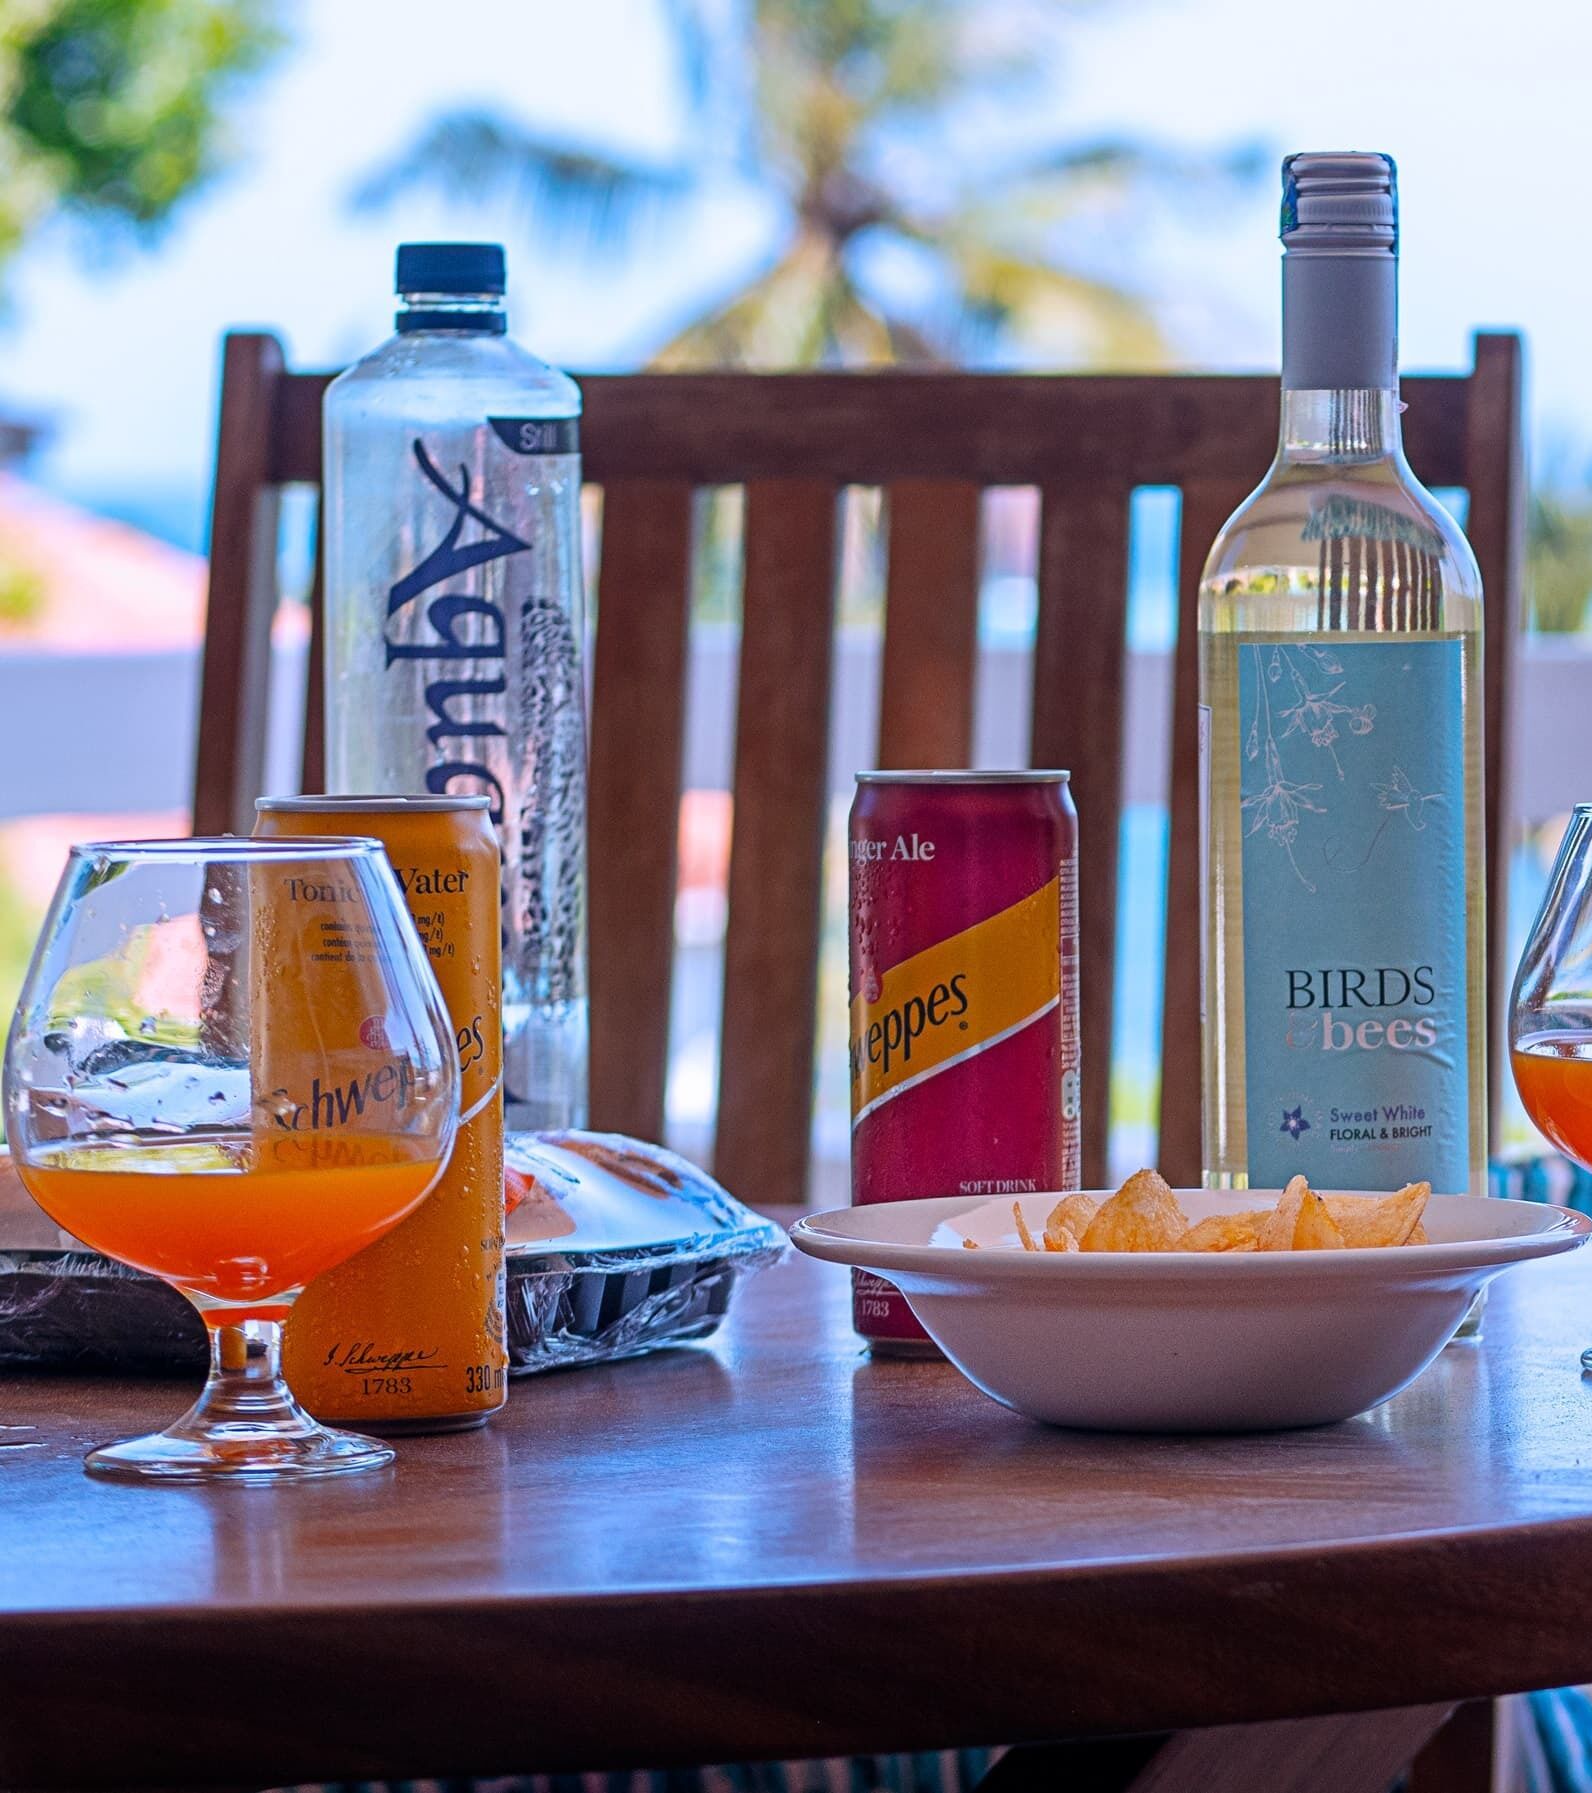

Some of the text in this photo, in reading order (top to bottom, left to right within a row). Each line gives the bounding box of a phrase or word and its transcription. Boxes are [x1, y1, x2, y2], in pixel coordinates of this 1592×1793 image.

[851, 833, 936, 867] nger Ale
[1285, 965, 1435, 1009] BIRDS
[1322, 1011, 1438, 1050] bees
[1330, 1105, 1426, 1123] Sweet White
[1330, 1125, 1433, 1141] FLORAL & BRIGHT
[960, 1178, 1037, 1194] SOFT DRINK
[862, 1300, 890, 1318] 1783
[362, 1377, 413, 1395] 1783
[466, 1364, 490, 1393] 330
